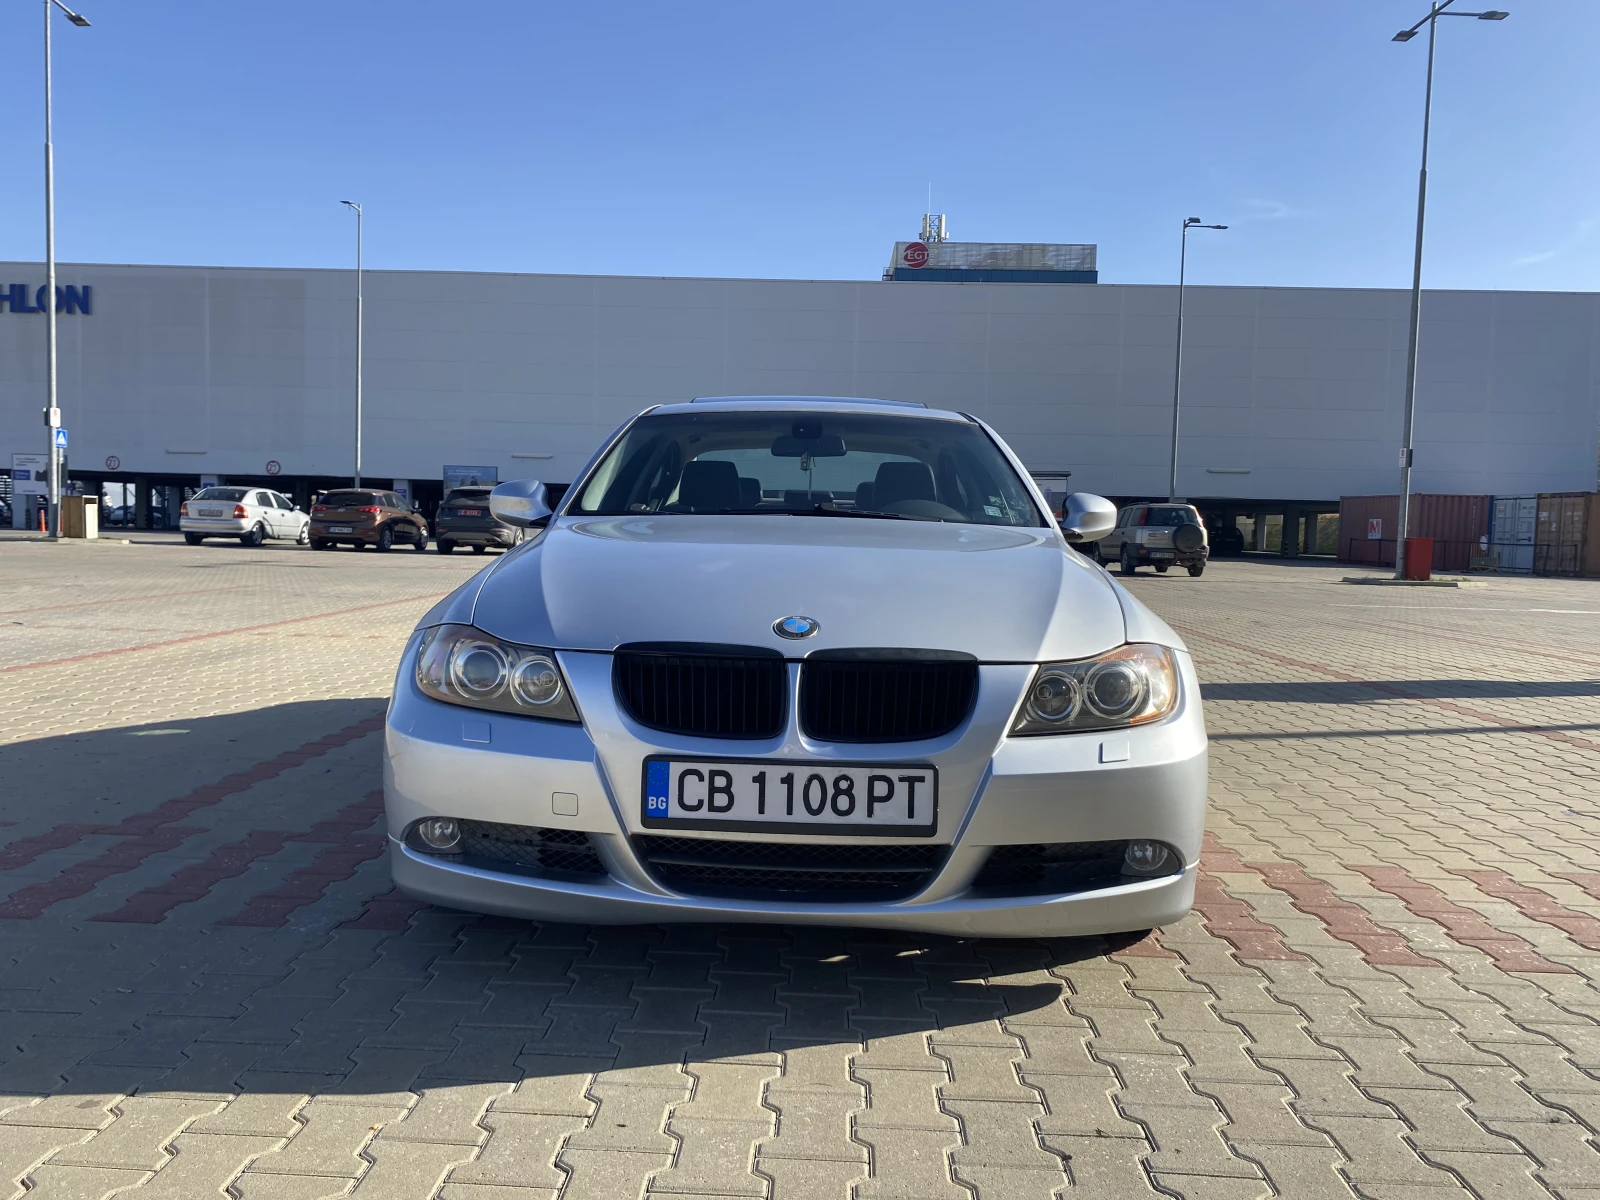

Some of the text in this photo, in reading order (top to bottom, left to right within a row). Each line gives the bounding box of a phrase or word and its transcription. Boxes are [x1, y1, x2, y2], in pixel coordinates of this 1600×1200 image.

[907, 251, 929, 260] EGT
[677, 768, 926, 819] CB 1108 PT
[648, 796, 667, 810] BG
